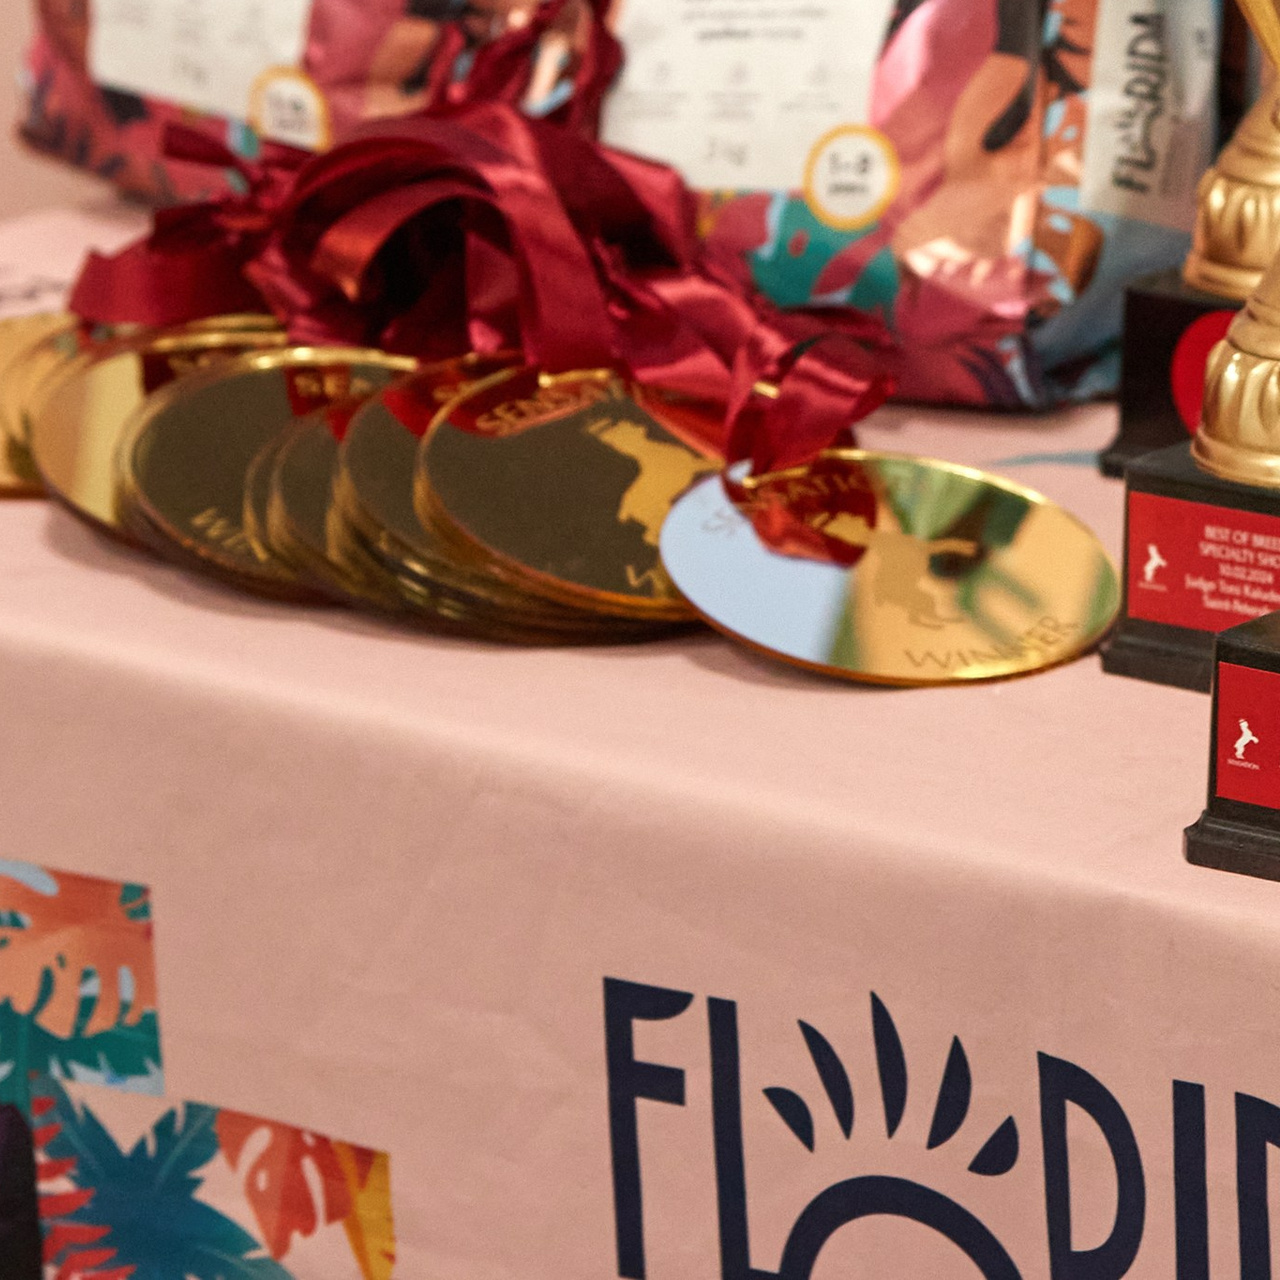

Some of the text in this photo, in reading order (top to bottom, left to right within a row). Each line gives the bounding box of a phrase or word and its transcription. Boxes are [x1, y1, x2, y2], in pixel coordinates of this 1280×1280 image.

[1204, 524, 1231, 542] BEST
[1232, 530, 1249, 545] OF
[1199, 540, 1255, 564] SPECIALTY
